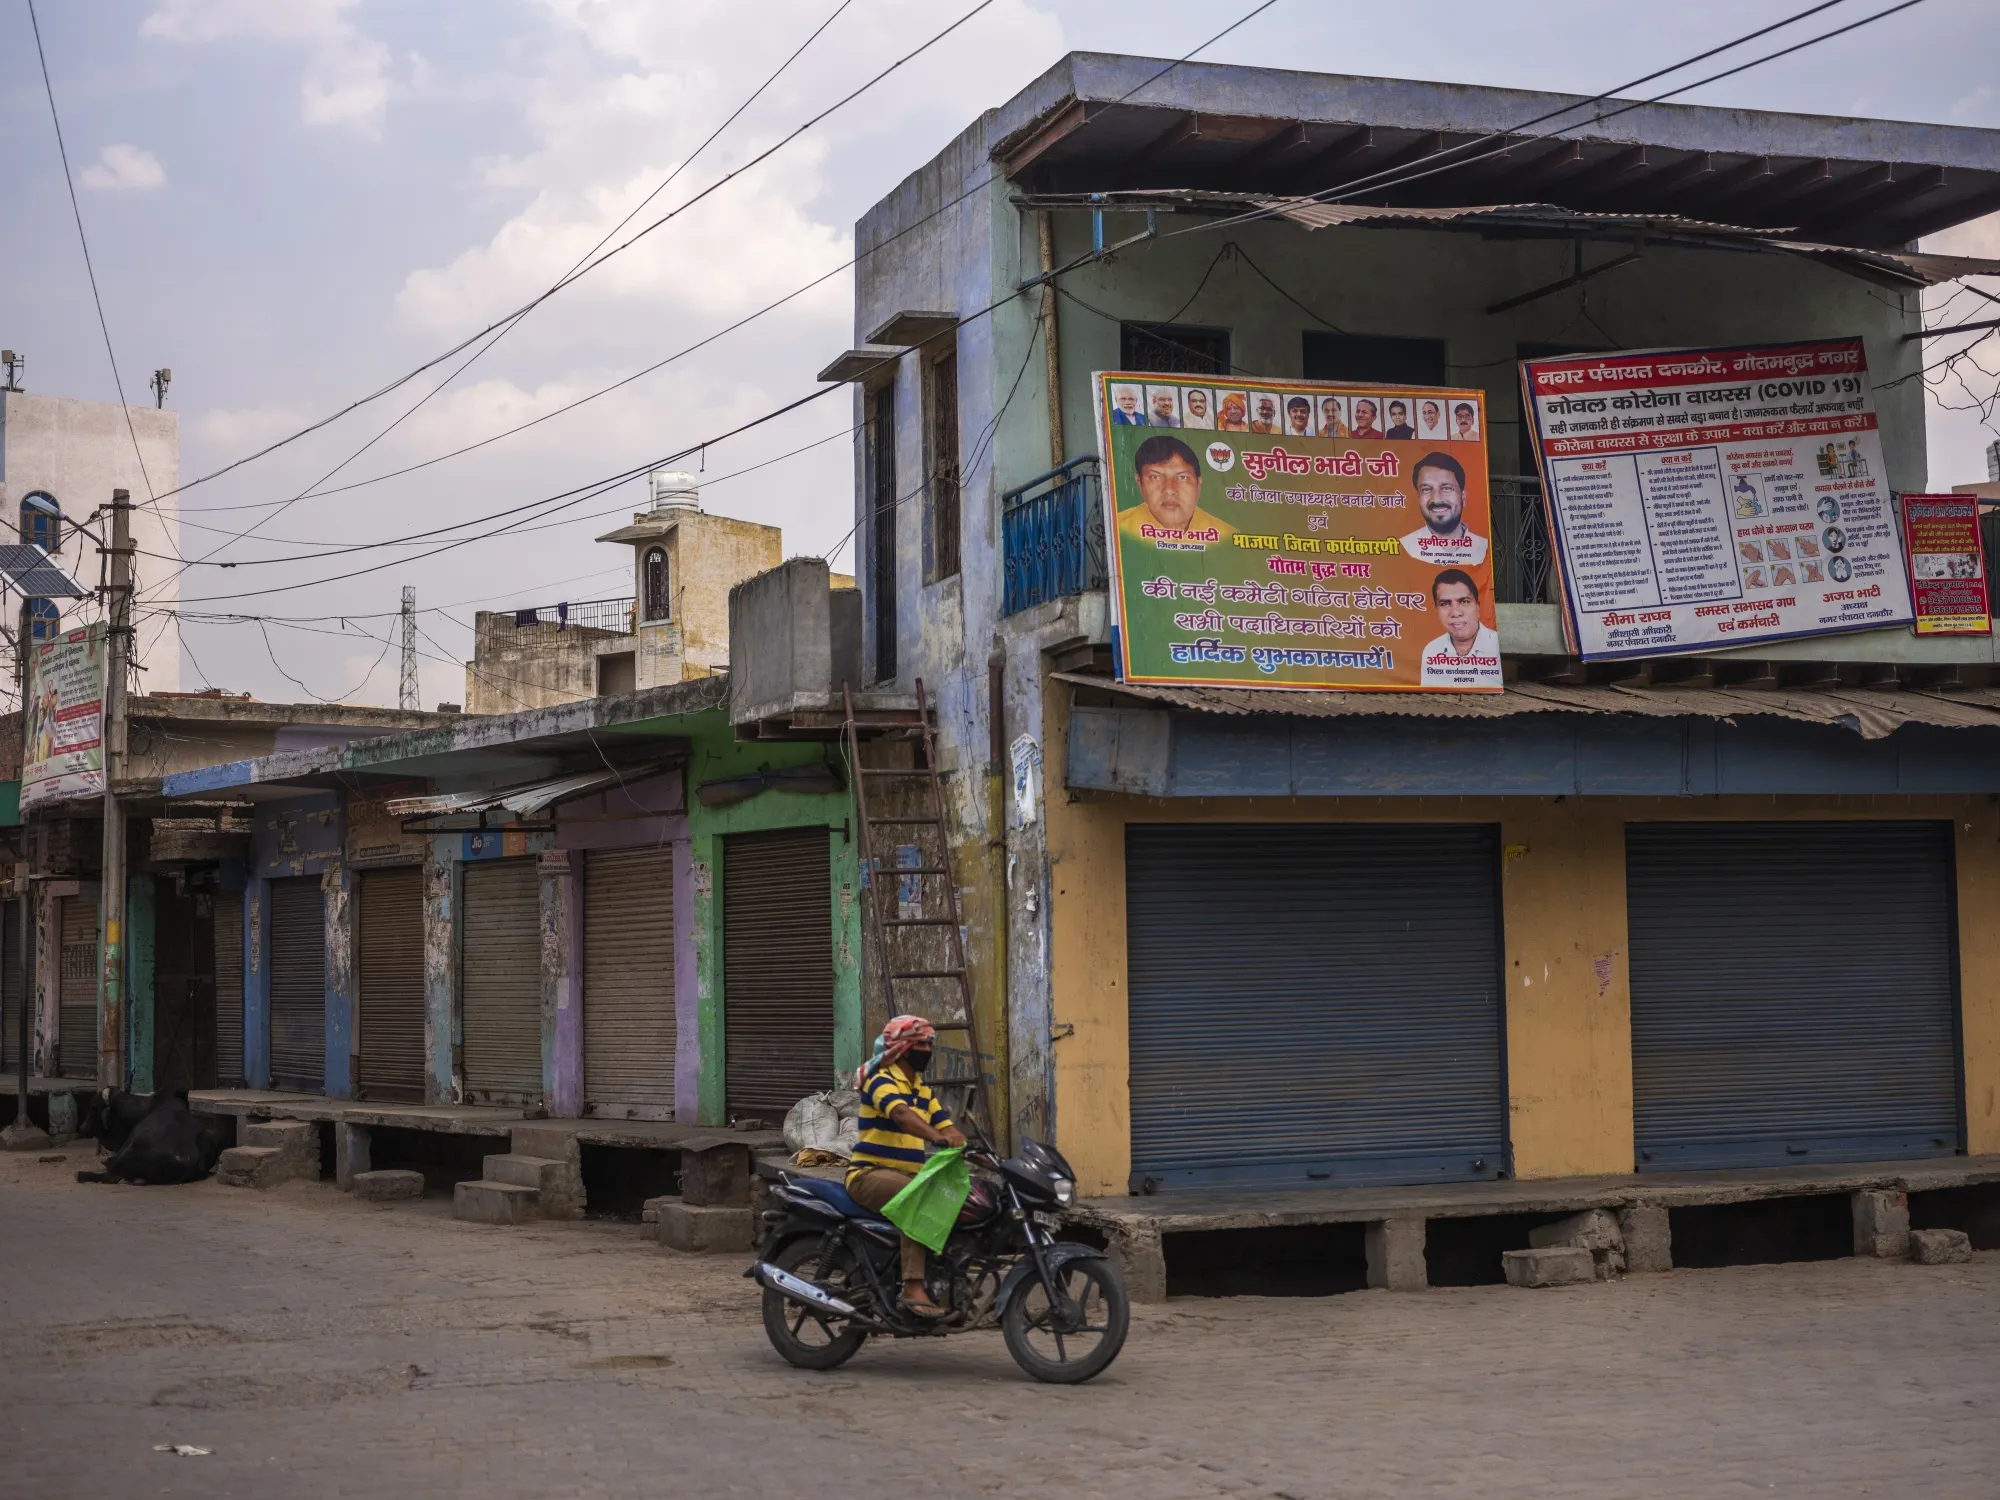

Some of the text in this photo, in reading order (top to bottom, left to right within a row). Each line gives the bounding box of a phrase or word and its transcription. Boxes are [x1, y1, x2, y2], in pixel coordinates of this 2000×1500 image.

[1537, 350, 1860, 385] नगर पंचायत दनकौर, गौतमबुद्ध नगर
[1547, 378, 1861, 414] नोवल कोरोना वायरस (COVID 19)
[1550, 420, 1567, 434] सही
[1570, 418, 1608, 432] जानकारी
[1610, 416, 1620, 430] ही
[1622, 415, 1654, 429] संक्रमण
[1656, 413, 1664, 425] से
[1666, 411, 1688, 424] सबसे
[1690, 412, 1706, 425] बड़ा
[1708, 409, 1730, 422] बचाव
[1744, 404, 1788, 418] जागरूकता
[1816, 402, 1844, 414] अफवाह
[1847, 396, 1864, 410] नहीं
[1554, 439, 1594, 452] कोरोना
[1598, 436, 1634, 449] वायरस
[1638, 435, 1649, 446] से
[1652, 432, 1683, 448] सुरक्षा
[1686, 429, 1698, 440] के
[1702, 428, 1730, 440] उपाय
[1743, 426, 1763, 436] क्या
[1766, 422, 1785, 434] करें
[1787, 421, 1806, 433] और
[1808, 420, 1828, 431] क्या
[1831, 420, 1840, 428] न
[1242, 446, 1399, 480] सुनील भाटी जी
[1661, 456, 1672, 464] क्या
[1681, 452, 1692, 462] करें
[1726, 452, 1744, 460] कोरोना
[1746, 451, 1762, 459] वायरस
[1752, 460, 1761, 468] और
[1596, 460, 1606, 470] करें
[1226, 484, 1405, 508] को जिला उपाध्यक्ष बनाये जाने
[1308, 512, 1328, 531] एवं
[1140, 524, 1220, 542] विजय भाटी
[1156, 540, 1178, 550] जिला
[1233, 532, 1400, 555] भाजपा जिला कार्यकारणी
[1418, 536, 1472, 550] सुनील भाटी
[1267, 554, 1371, 580] गौतम बुद्ध नगर
[1142, 576, 1176, 600] की
[1180, 578, 1218, 604] नई
[1292, 584, 1350, 608] गठित
[1352, 585, 1392, 610] होने
[1395, 590, 1426, 610] पर
[1823, 584, 1881, 602] अजय भाटी
[1695, 597, 1796, 617] समस्त सभासद गण
[1841, 602, 1868, 610] अध्यक्ष
[1174, 608, 1401, 638] सभी पदाधिकारियों को
[1602, 610, 1671, 626] सीमा राघव
[1718, 613, 1780, 632] एवं कर्मचारी
[1819, 616, 1837, 624] नगर
[1838, 612, 1864, 621] पंचायत
[1642, 624, 1672, 636] अधिकारी
[1606, 634, 1676, 647] नगर पंचायत दनकौर
[1170, 638, 1394, 673] हार्दिक शुभकामनायें।
[1426, 652, 1498, 666] अनिल गोयल
[472, 838, 482, 849] Jio
